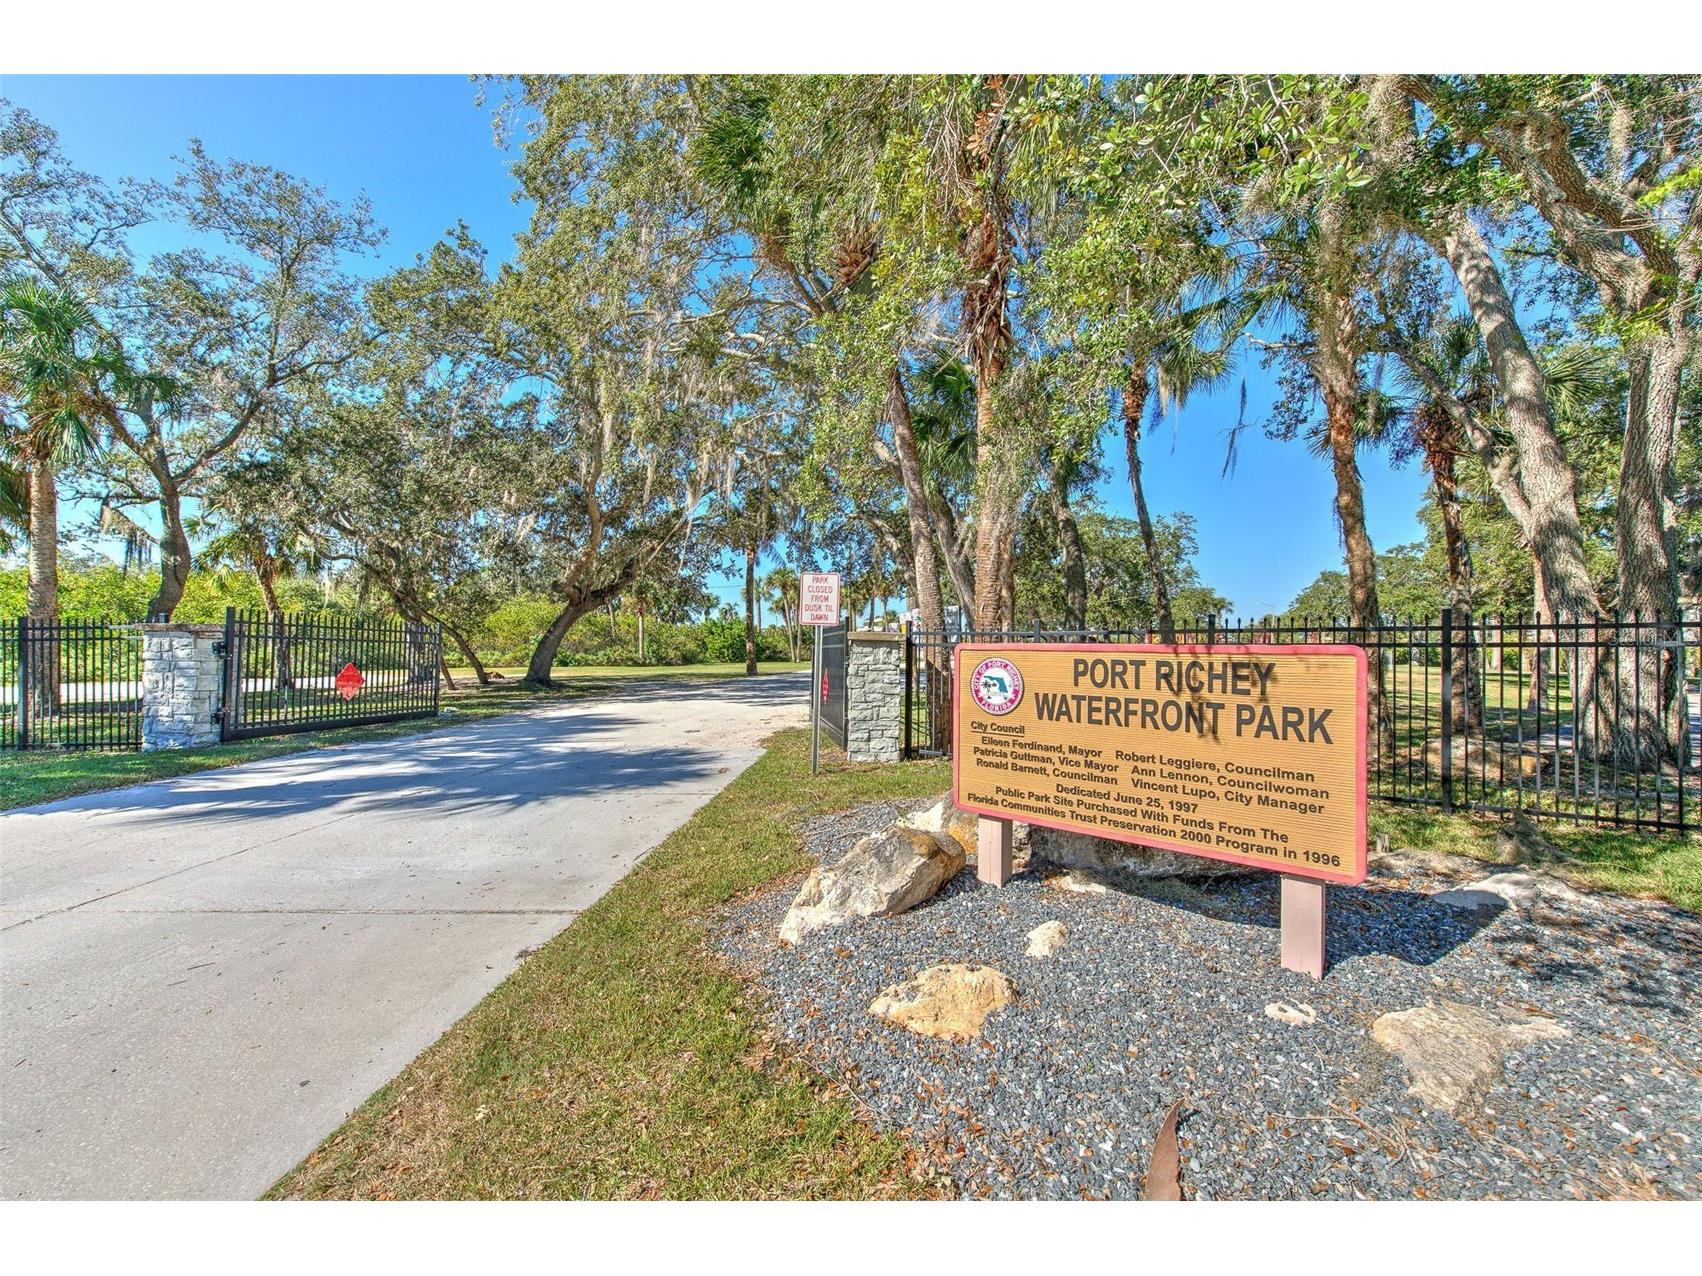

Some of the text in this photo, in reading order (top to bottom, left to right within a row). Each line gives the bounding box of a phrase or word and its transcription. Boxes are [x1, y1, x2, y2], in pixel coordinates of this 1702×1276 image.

[805, 604, 822, 612] DUSK
[1006, 664, 1020, 690] RICHEY
[1073, 658, 1276, 696] PORT RICHEY
[981, 700, 1012, 711] FLORIDA
[1034, 692, 1334, 744] WATERFRONT PARK
[970, 720, 1025, 734] City Council
[974, 747, 1329, 799] Patricia Guttman, Vice Mayor Ann Lennon, Councilwoman
[981, 736, 1315, 782] Eileen Ferdinand, Mayor Robert Leggiere, Councilman
[976, 758, 1324, 814] Ronald Barnett, Councilman Vincent Lupo, City Manager
[1056, 784, 1198, 813] Dedicated June 25, 1997
[968, 793, 1341, 867] Florida Communities Trust Preservation 2000 Program in 1996
[995, 786, 1289, 842] Public Park Site Purchased With Funds From The
